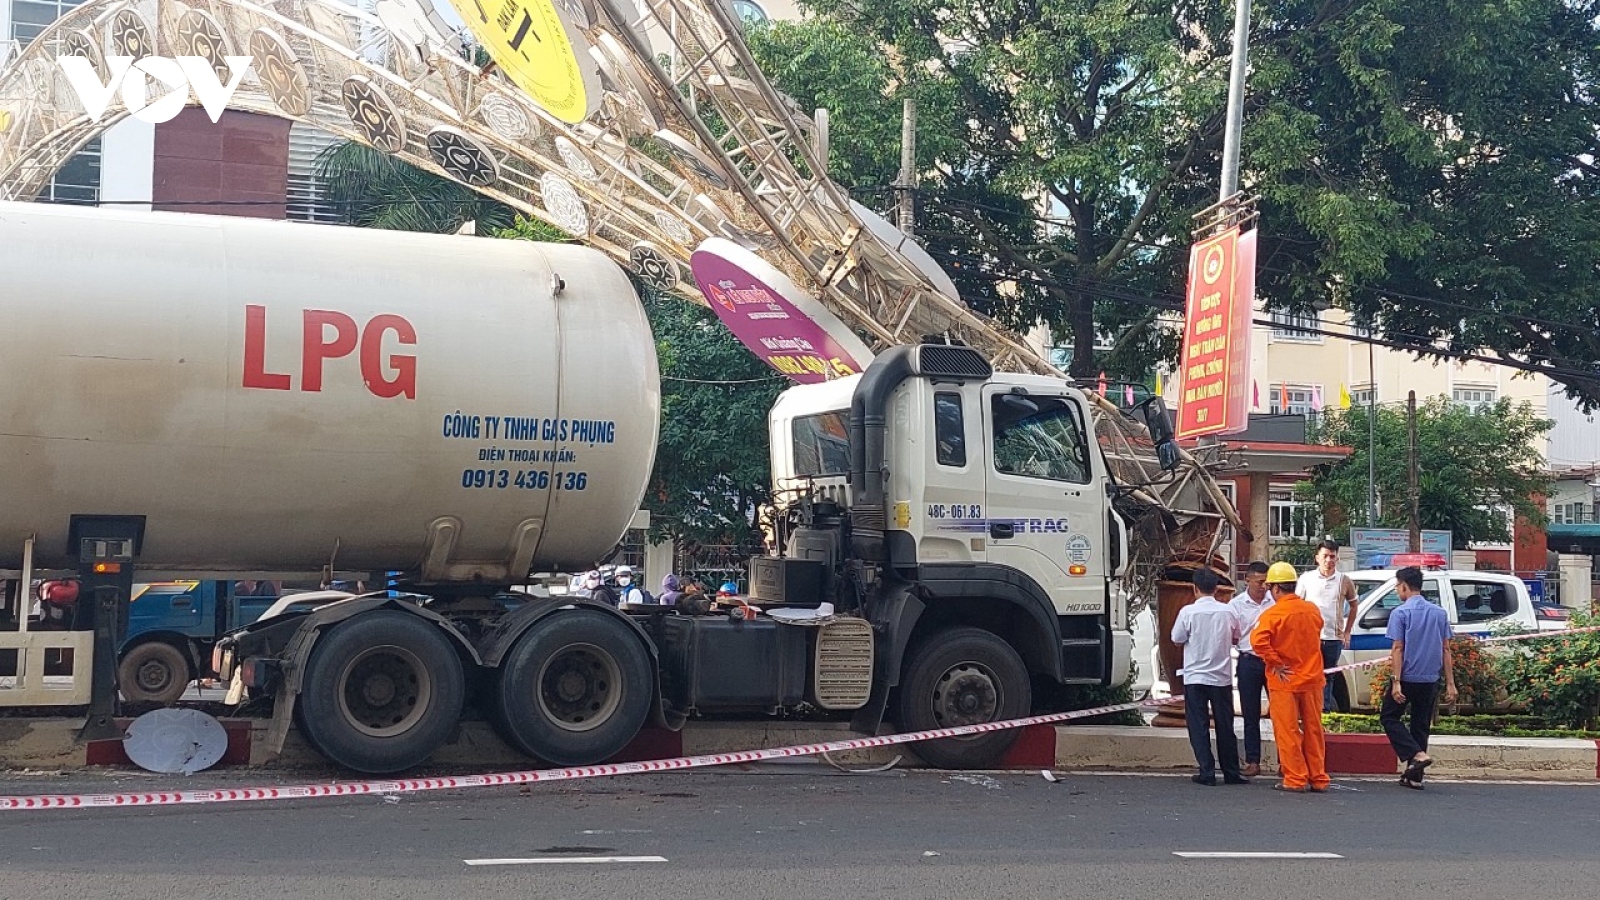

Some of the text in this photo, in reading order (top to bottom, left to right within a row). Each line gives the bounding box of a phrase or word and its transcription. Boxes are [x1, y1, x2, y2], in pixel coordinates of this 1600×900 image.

[242, 304, 417, 401] LPG
[443, 409, 615, 447] CÔNG TY TNHH GAS PHỤNG
[478, 446, 505, 464] ĐIỆN
[508, 449, 540, 465] THOẠI
[462, 469, 588, 491] 0913 436 136
[928, 504, 981, 519] 48C-061.83
